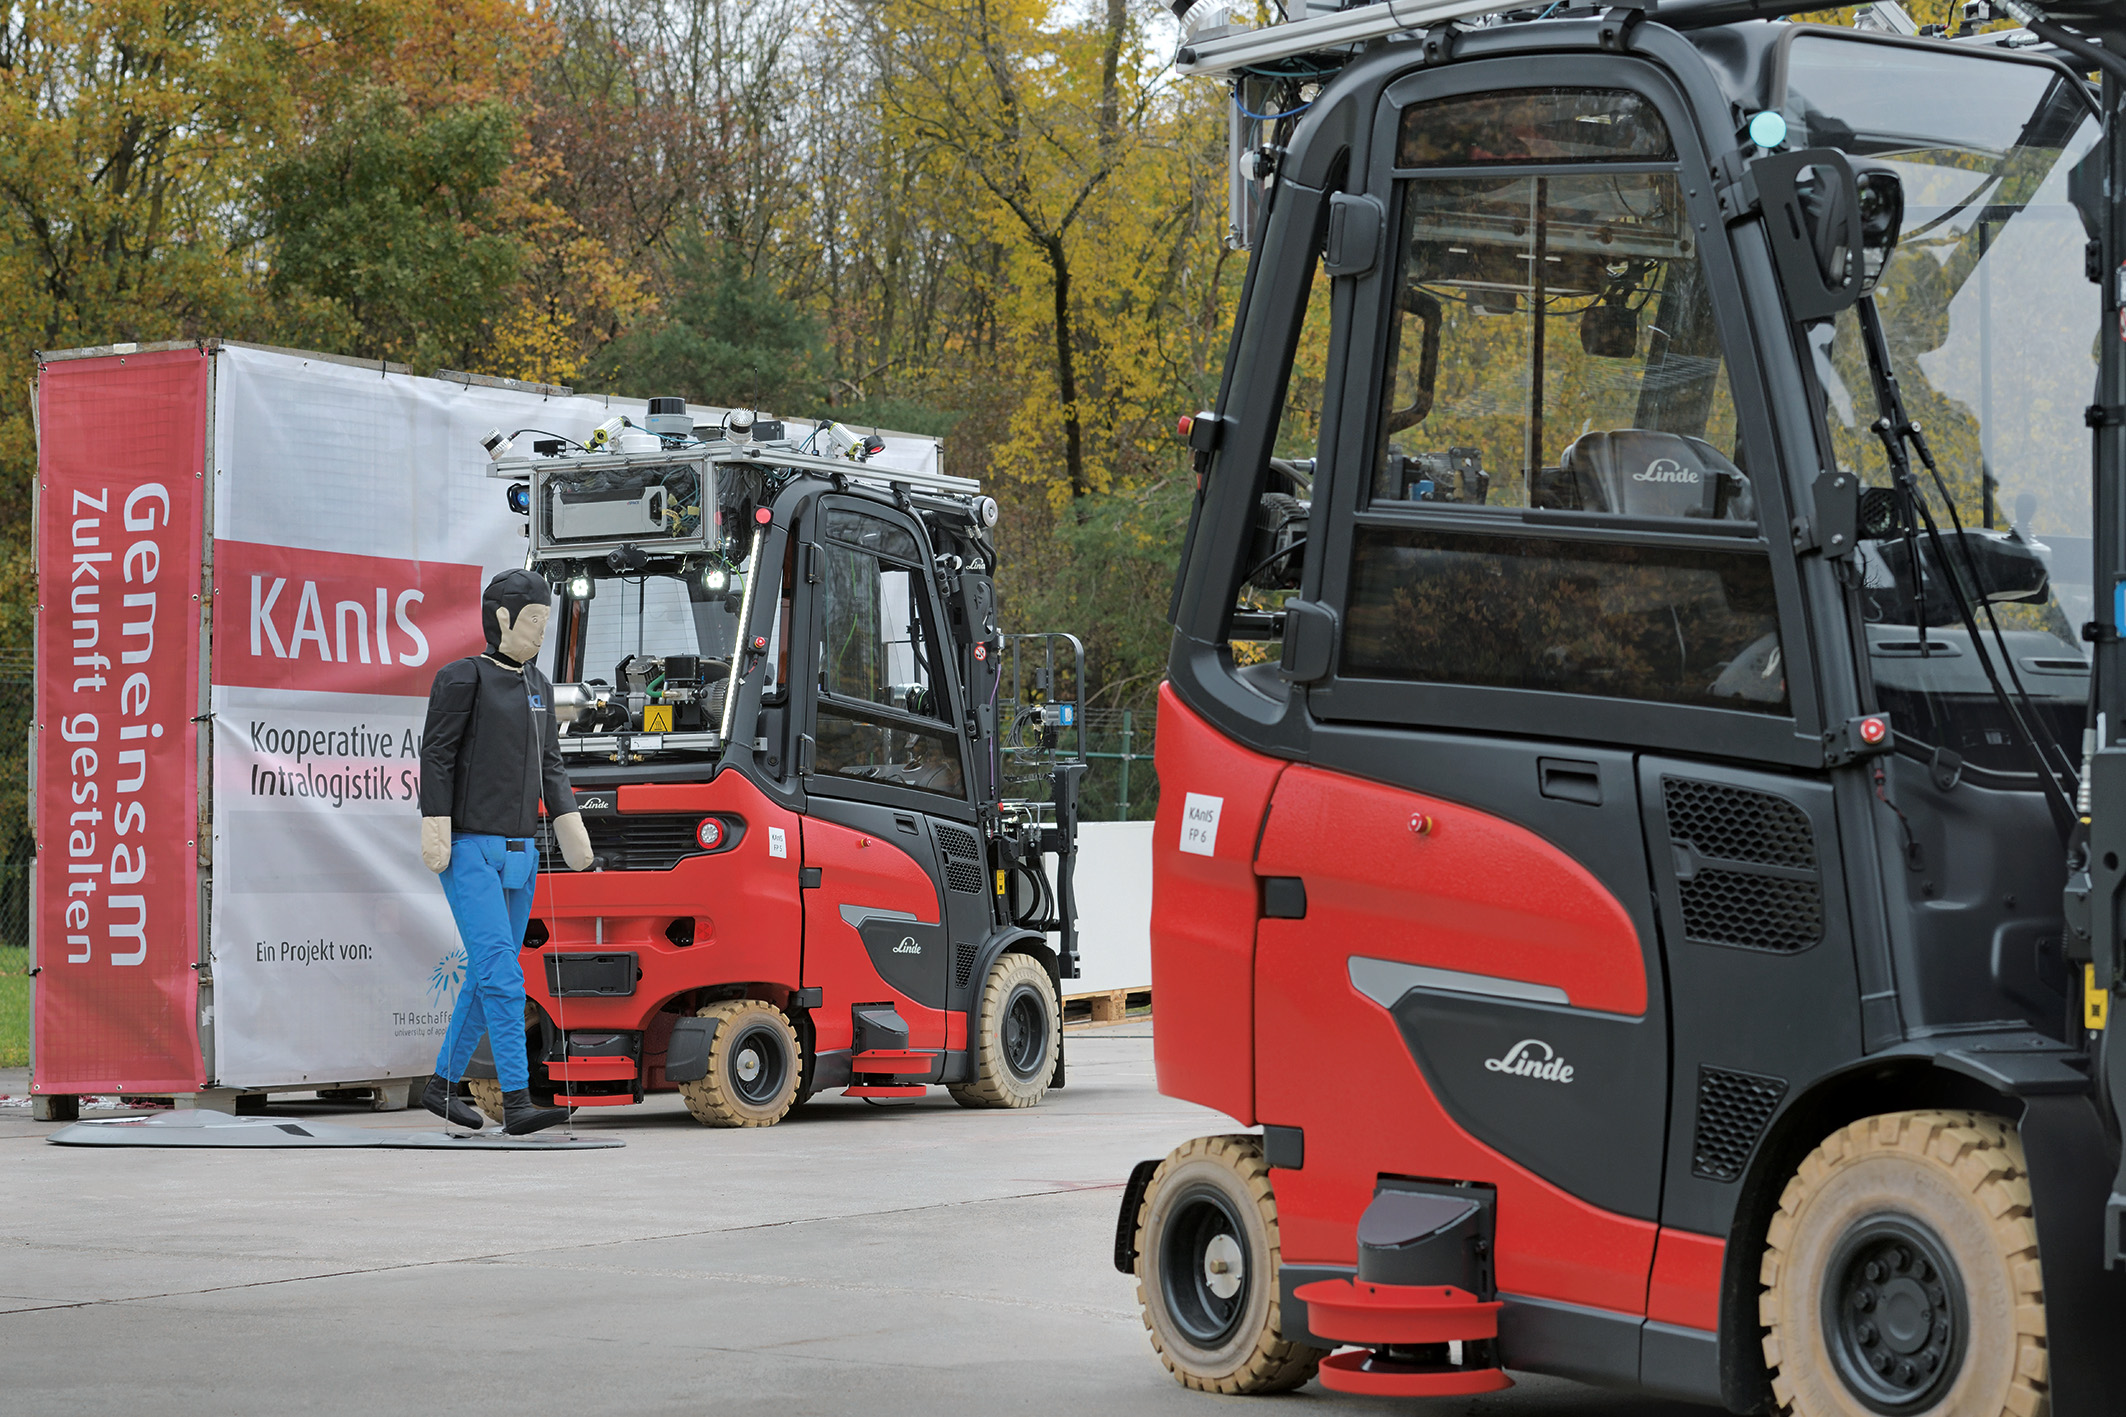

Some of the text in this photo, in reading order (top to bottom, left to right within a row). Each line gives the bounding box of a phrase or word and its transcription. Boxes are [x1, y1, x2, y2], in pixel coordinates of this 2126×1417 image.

[1632, 458, 1700, 484] Linde
[250, 574, 430, 667] KAnIS
[61, 487, 112, 964] Zukunft gestalten
[107, 482, 171, 966] Gemeinsam
[250, 721, 393, 764] Kooperative
[251, 763, 394, 808] Intralogistik
[578, 797, 609, 810] Linde
[1189, 806, 1214, 823] KAnIS
[1188, 828, 1207, 843] FP 6
[256, 939, 373, 967] Ein Projekt von:
[892, 936, 922, 955] Linde
[392, 1012, 406, 1026] TH
[394, 1028, 426, 1037] university
[427, 1027, 434, 1036] of
[1484, 1038, 1575, 1084] Linde
